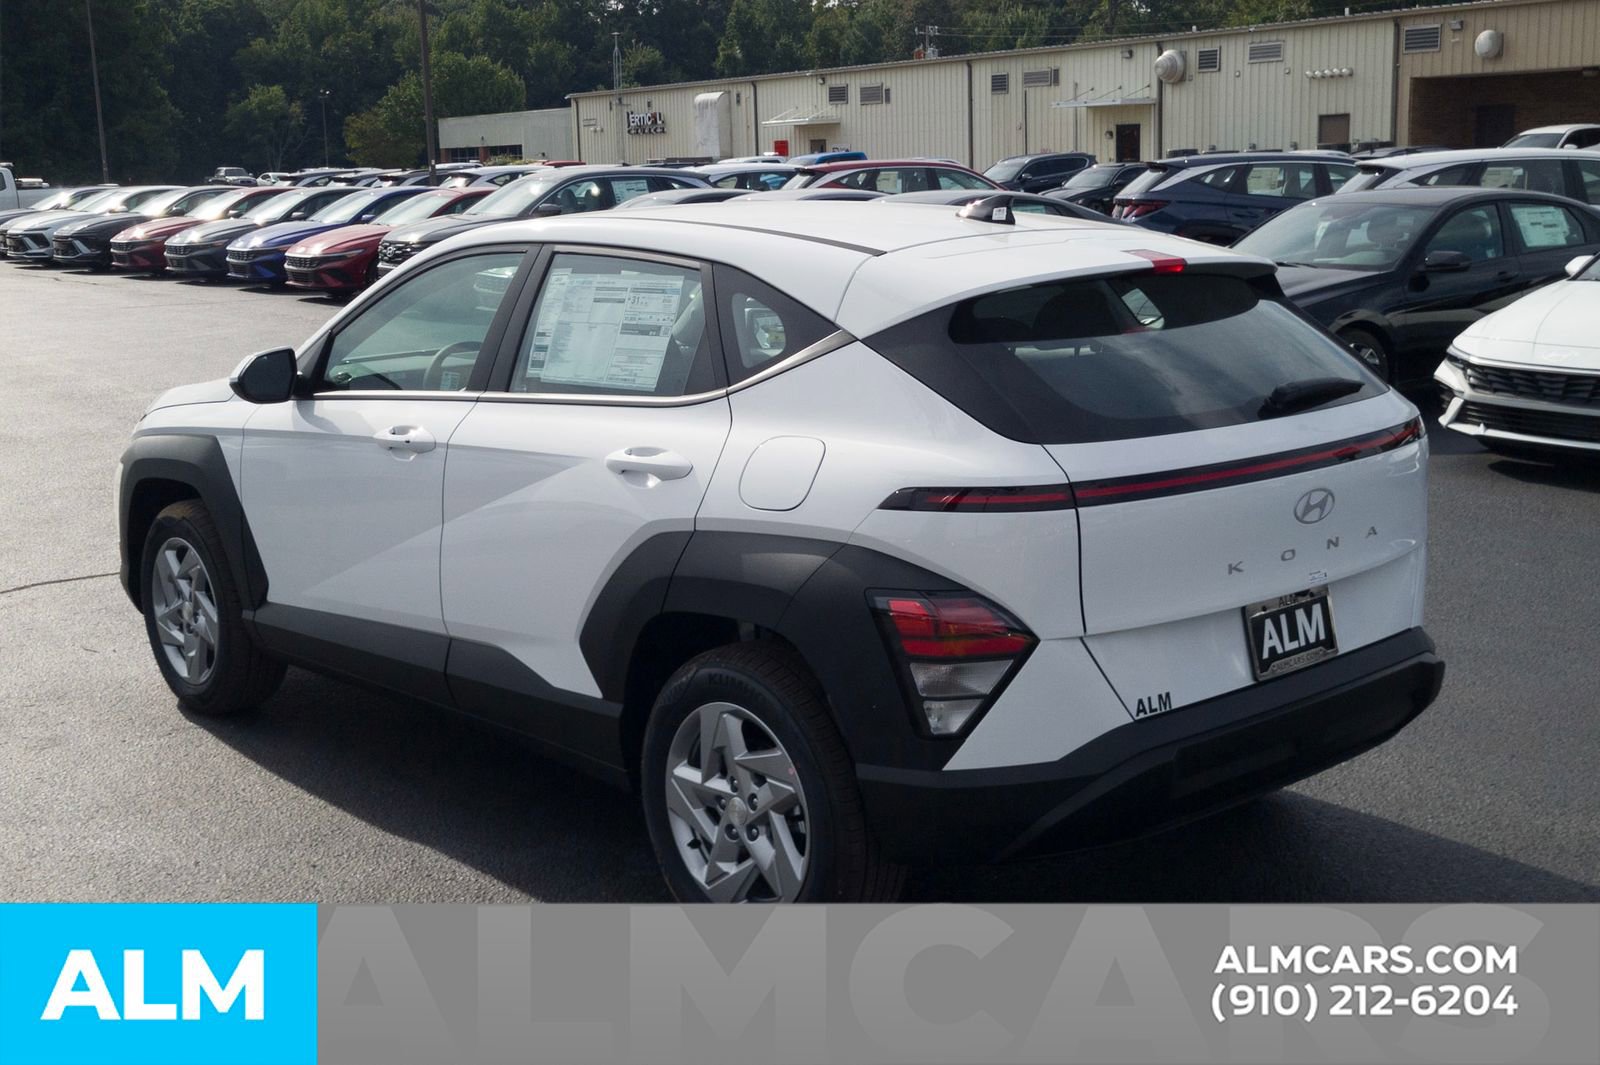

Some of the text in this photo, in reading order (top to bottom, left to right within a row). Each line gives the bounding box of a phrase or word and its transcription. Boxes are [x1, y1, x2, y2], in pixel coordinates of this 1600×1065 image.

[1227, 526, 1378, 576] KONA
[1262, 603, 1326, 660] ALM
[1135, 691, 1172, 718] ALM
